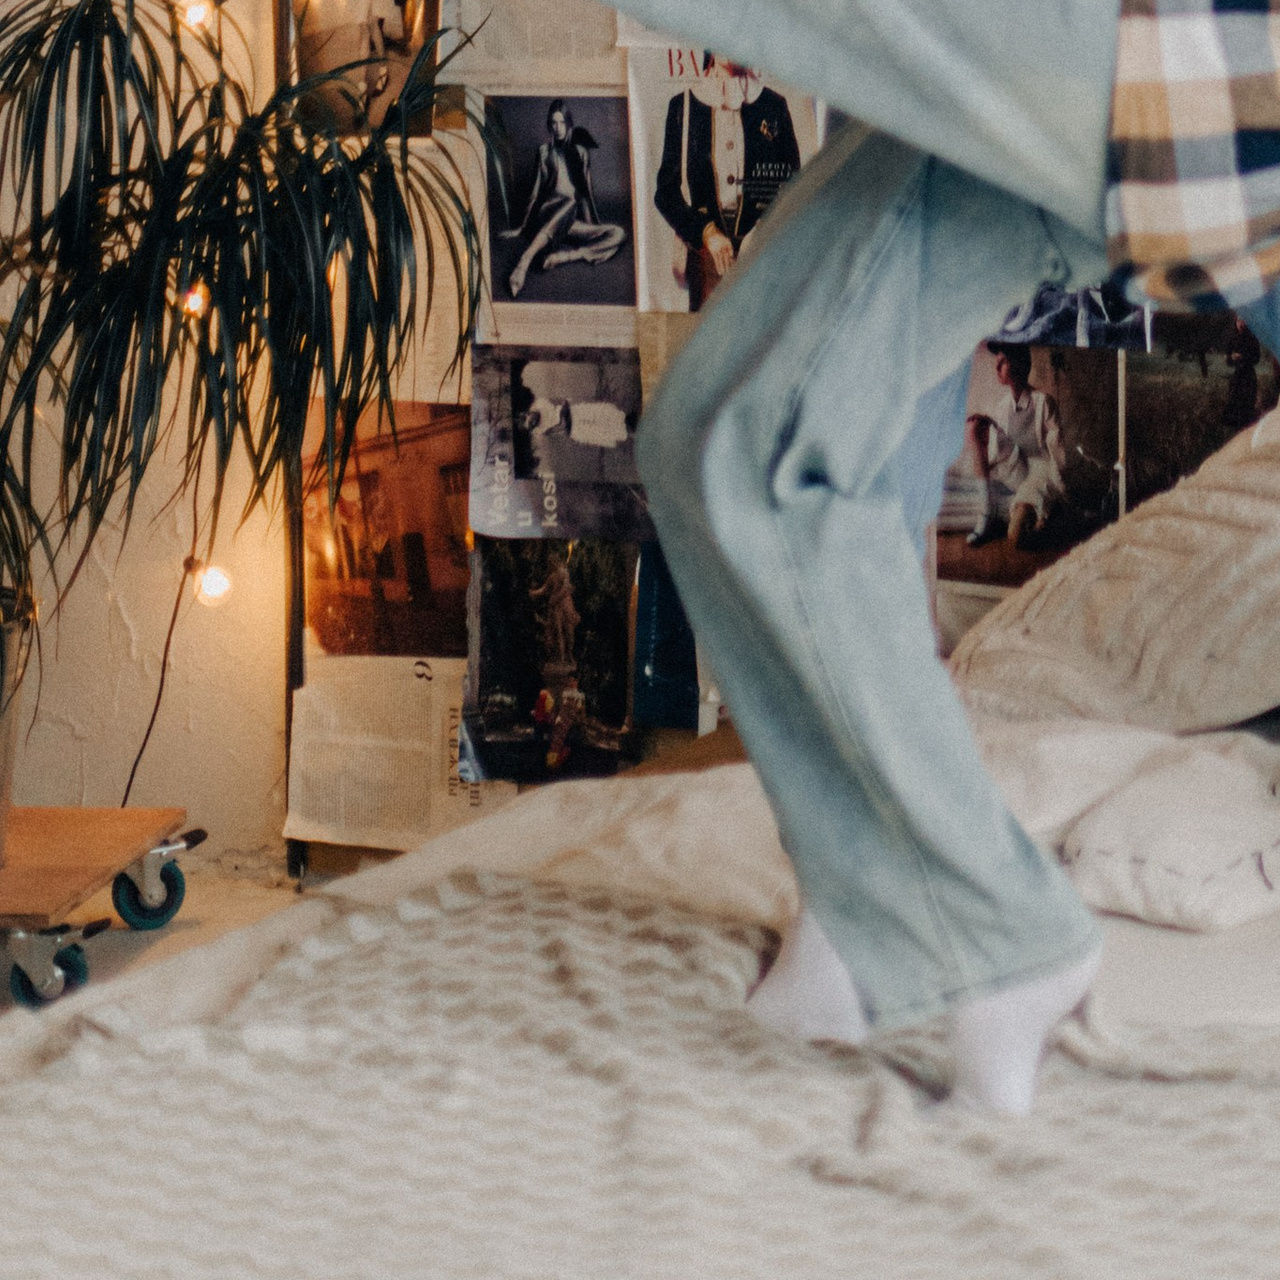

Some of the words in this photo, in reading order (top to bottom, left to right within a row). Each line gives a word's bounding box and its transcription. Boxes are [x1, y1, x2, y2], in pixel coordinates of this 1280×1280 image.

[486, 454, 511, 526] Vetar
[537, 471, 559, 528] kosi
[517, 511, 533, 527] u
